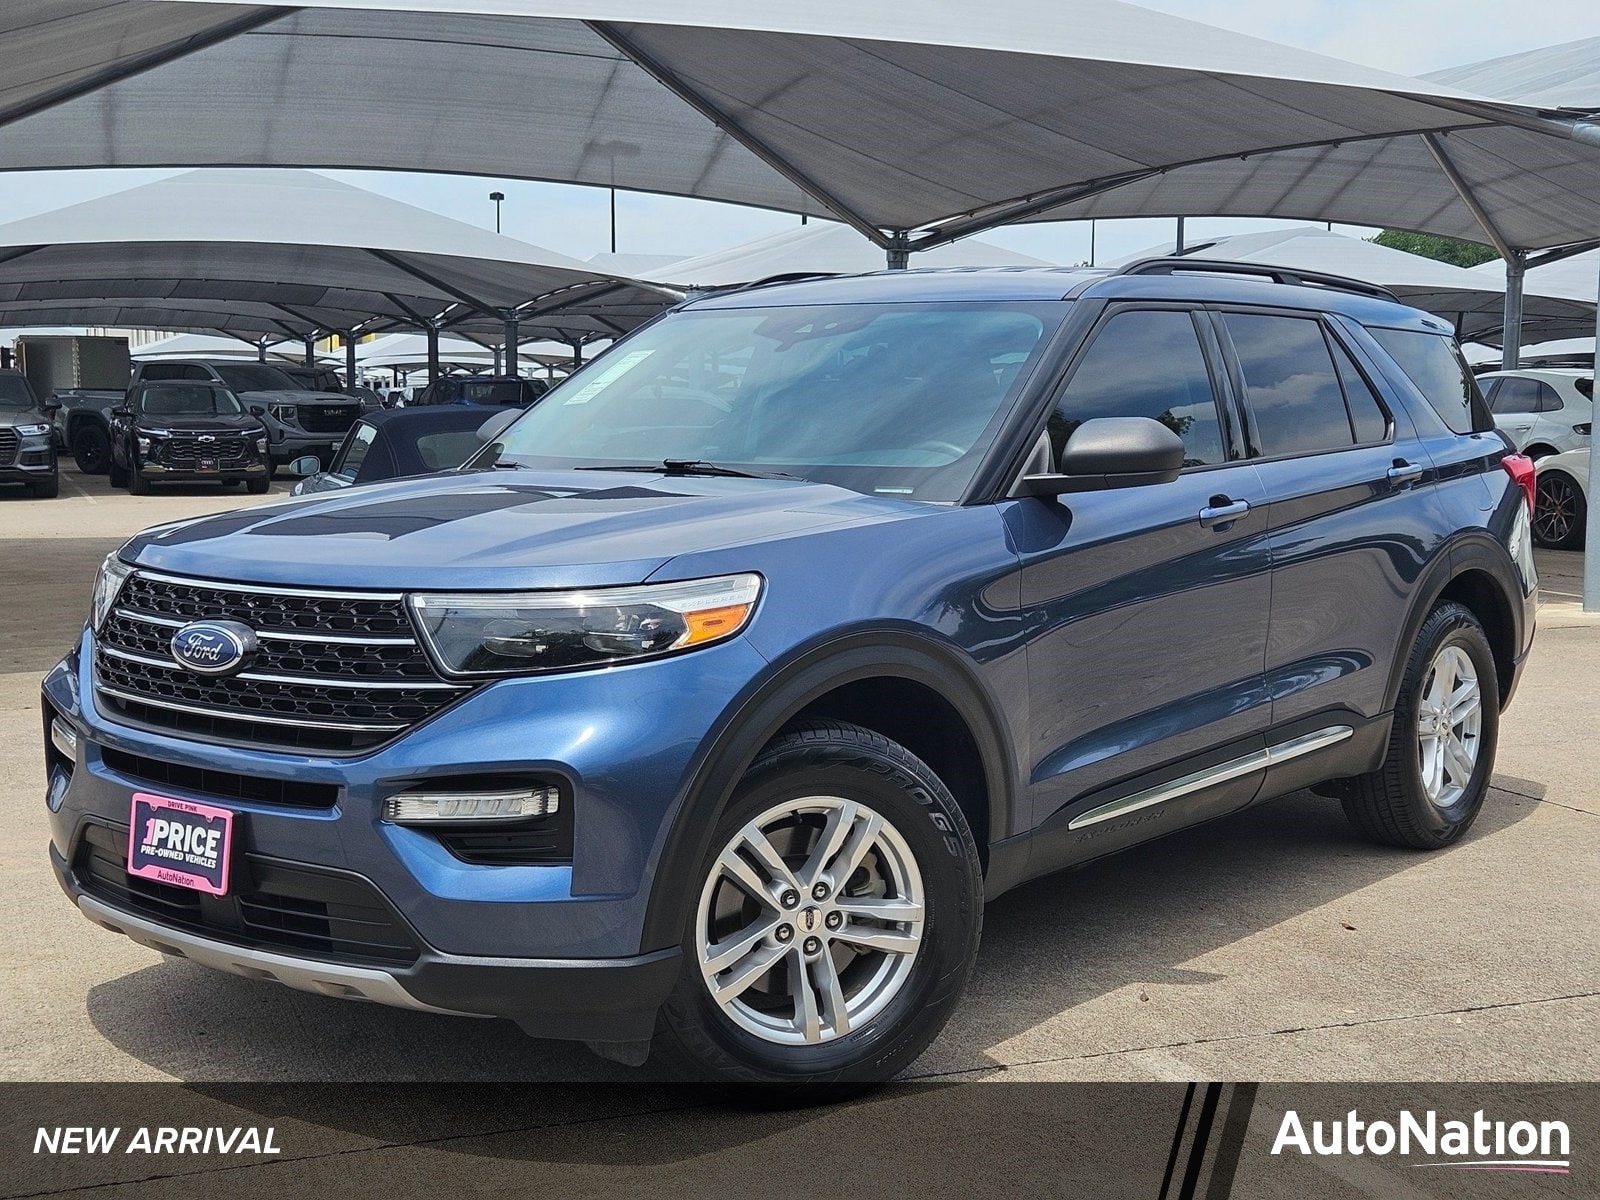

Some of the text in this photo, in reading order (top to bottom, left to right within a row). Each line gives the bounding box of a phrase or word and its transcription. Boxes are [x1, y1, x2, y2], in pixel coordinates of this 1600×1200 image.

[183, 633, 223, 661] Ford
[167, 801, 198, 812] DRIVE PINK
[142, 818, 221, 859] 1PRICE
[140, 845, 217, 869] PRE-OWNED VEHICLES
[157, 870, 195, 886] AutoNation
